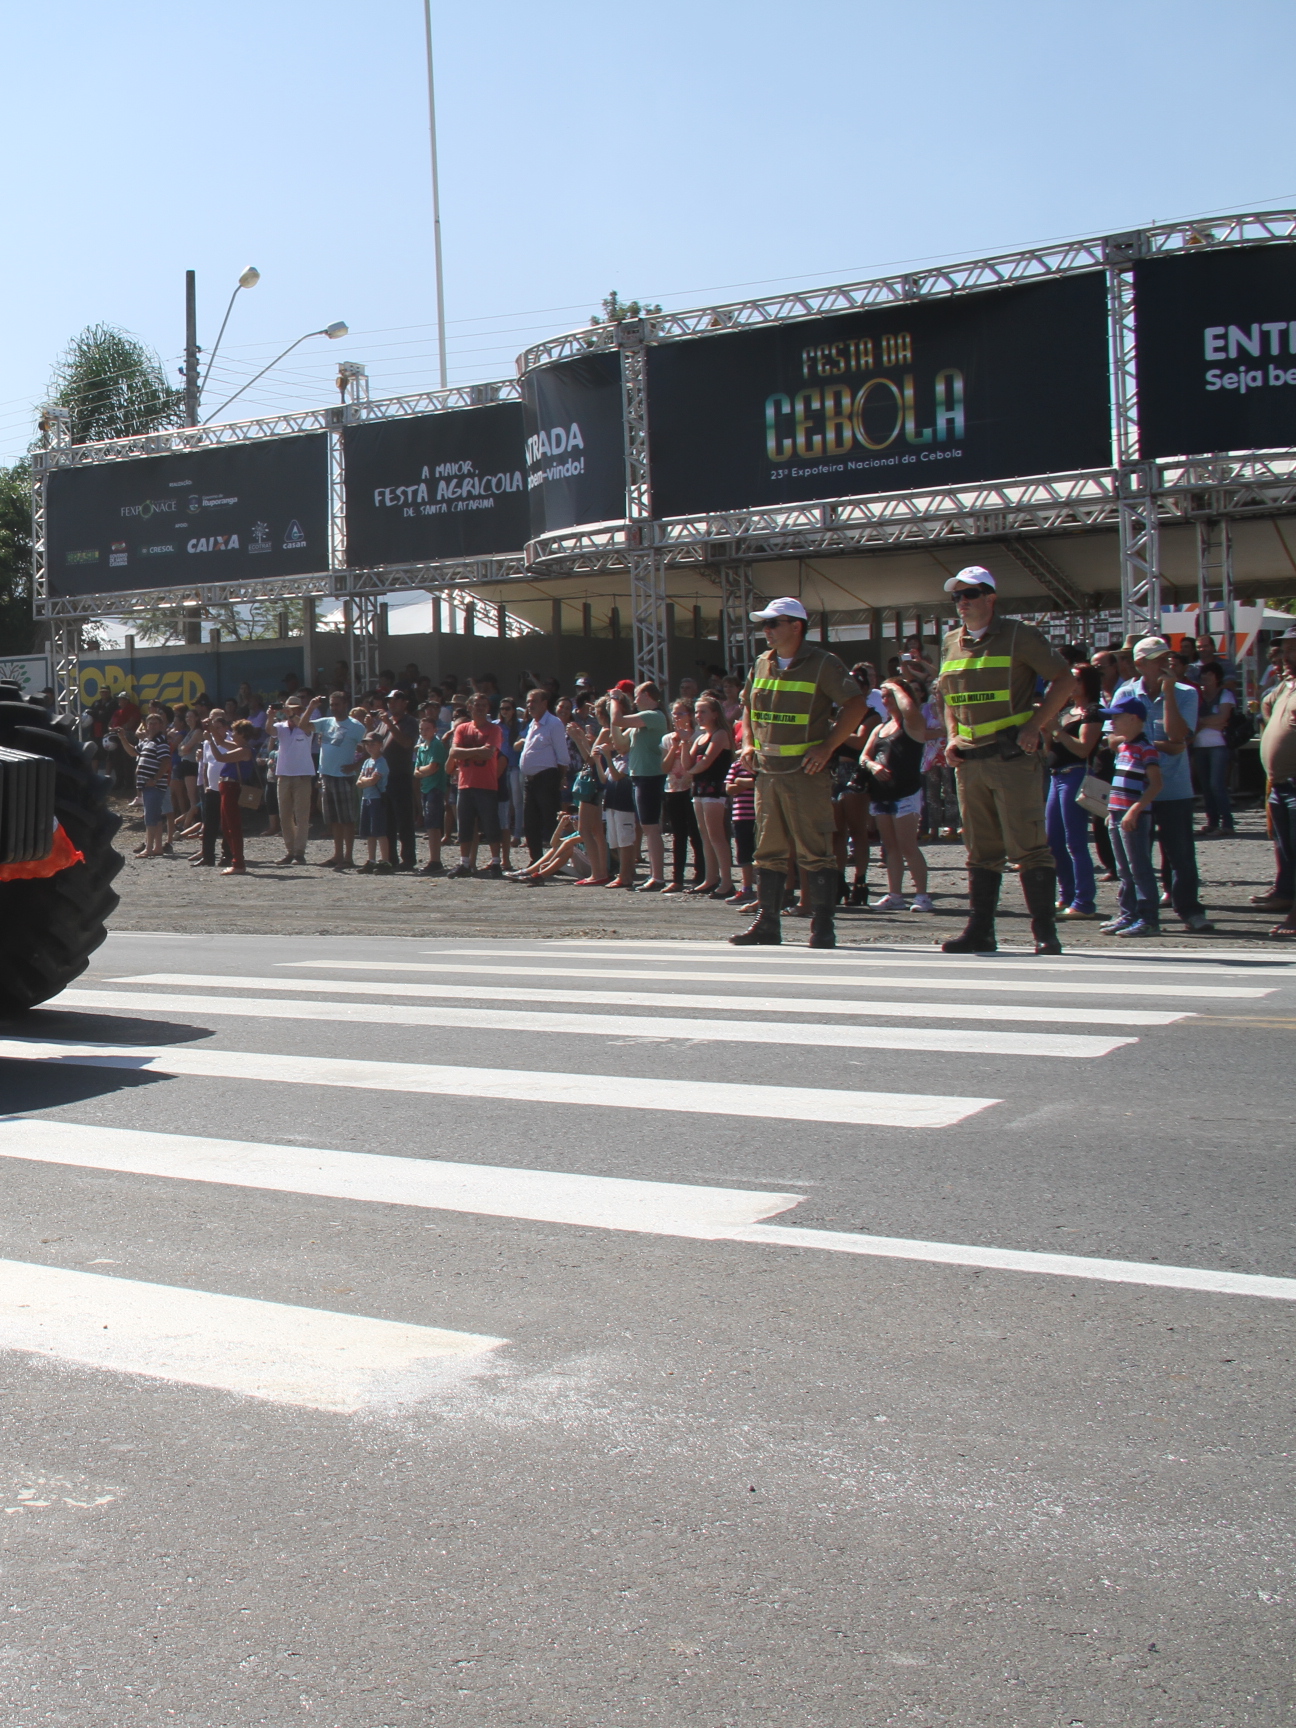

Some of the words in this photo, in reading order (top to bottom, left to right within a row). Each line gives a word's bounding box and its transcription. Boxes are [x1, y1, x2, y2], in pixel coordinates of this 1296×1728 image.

[802, 337, 874, 380] FESTA
[881, 331, 912, 368] DA
[1205, 365, 1263, 394] Seja
[765, 367, 966, 463] CEBOLA
[421, 465, 430, 479] A
[791, 463, 844, 478] Expofeira
[847, 454, 899, 471] Nacional
[901, 454, 916, 464] da
[920, 448, 963, 462] Cebola
[374, 483, 429, 508] FESTA
[404, 507, 416, 517] DE
[420, 502, 447, 514] SANTA
[451, 497, 494, 512] CATARINA
[149, 544, 175, 554] CRESOL
[187, 534, 240, 554] CAIXA
[283, 541, 306, 549] casan
[967, 692, 995, 702] MILITAR
